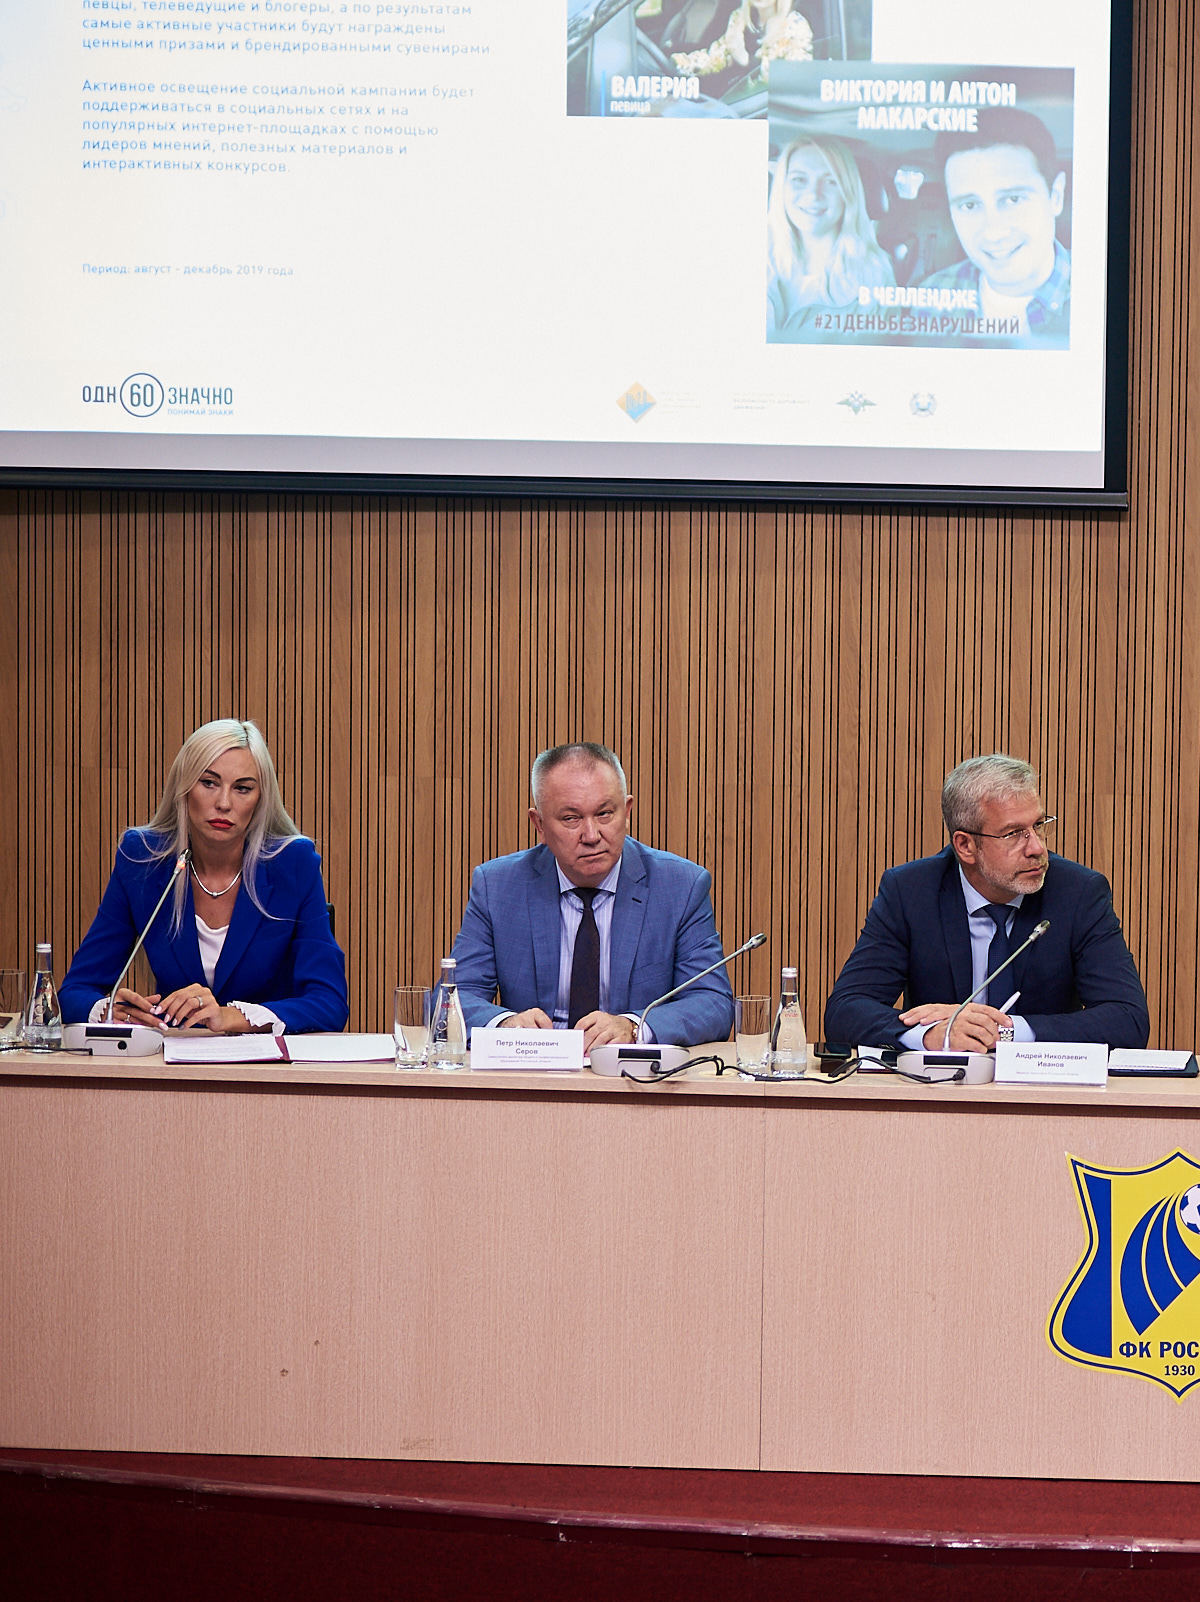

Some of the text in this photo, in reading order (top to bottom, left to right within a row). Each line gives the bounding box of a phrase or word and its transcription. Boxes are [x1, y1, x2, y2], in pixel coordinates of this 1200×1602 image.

[83, 0, 471, 20] певцы, телеведущие и блогеры, а по результатам
[83, 19, 445, 38] самые активные участники будут награждены
[83, 39, 153, 51] ценными
[160, 40, 225, 54] призами
[232, 41, 238, 51] и
[245, 37, 390, 56] брендированными
[82, 78, 474, 101] Активное освещение социальной кампании будет
[611, 76, 700, 99] ВАЛЕРИЯ
[820, 79, 1017, 106] ВИКТОРИЯ И АНТОН
[83, 101, 408, 117] поддерживаться в социальных сетях и на
[610, 100, 651, 114] певица
[857, 106, 979, 132] МАКАРСКИЕ
[83, 121, 438, 138] популярных интернет-площадках с помощью
[82, 137, 406, 158] лидеров мнений, полезных материалов и
[83, 159, 201, 174] интерактивных
[859, 287, 978, 310] В ЧЕЛЛЕНДЖЕ
[814, 313, 1021, 336] #21ДЕНЬБЕЗНАРУШЕНИЙ
[82, 383, 233, 407] ОДН 60 ЗНАЧНО
[1015, 1052, 1042, 1060] Андрей
[1118, 1341, 1151, 1358] ФК
[1164, 1365, 1195, 1376] 1930
